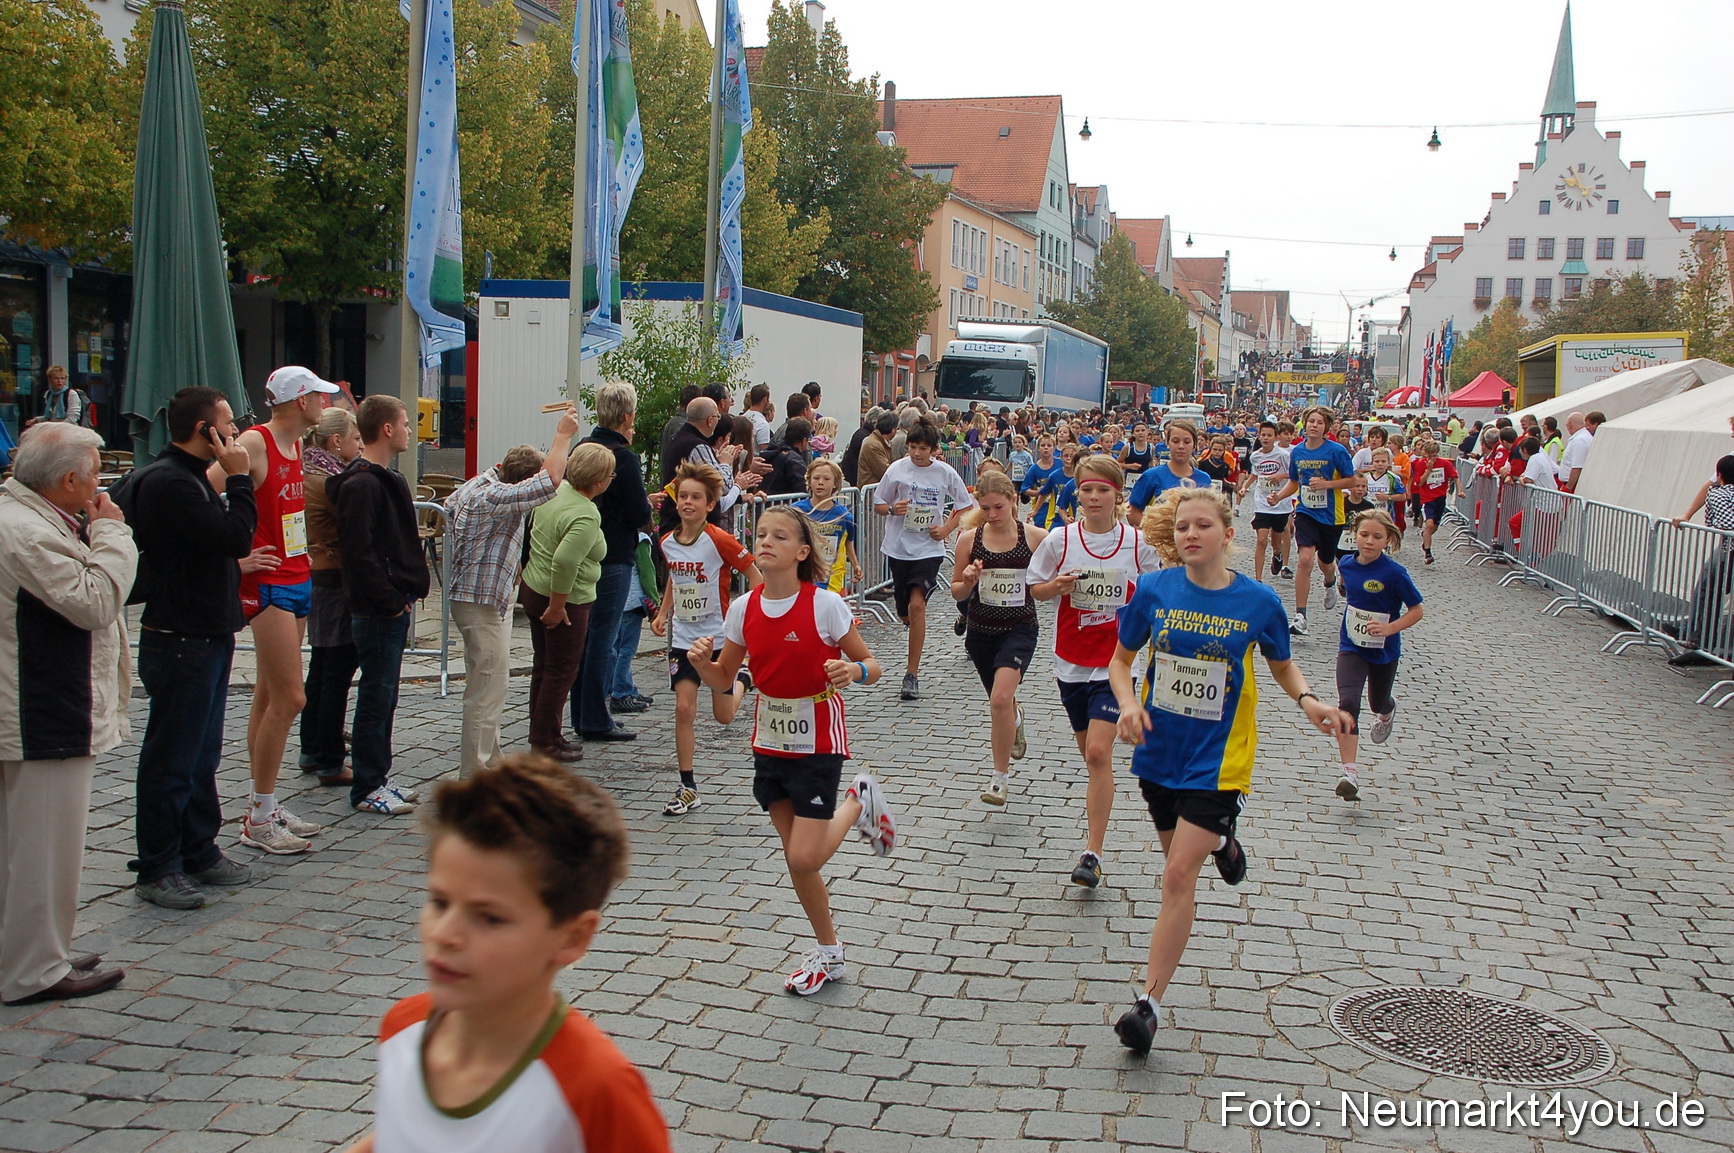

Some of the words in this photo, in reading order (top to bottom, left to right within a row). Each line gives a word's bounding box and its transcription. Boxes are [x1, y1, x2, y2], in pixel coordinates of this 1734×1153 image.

[1290, 374, 1319, 382] START
[1307, 494, 1326, 502] 4019
[913, 515, 935, 525] 4017
[668, 561, 705, 572] MERZ
[990, 570, 1016, 580] Ramona
[1087, 569, 1105, 580] Alina
[678, 587, 696, 595] Moritz
[991, 582, 1022, 594] 4023
[1086, 583, 1123, 598] 4039
[681, 597, 709, 610] 4067
[1155, 608, 1167, 619] 10.
[1167, 608, 1249, 633] NEUMARKTER
[1162, 618, 1232, 639] STADTLAUF
[1171, 660, 1208, 678] Tamara
[1170, 678, 1218, 701] 4030
[767, 700, 793, 714] Amelie
[769, 718, 809, 735] 4100
